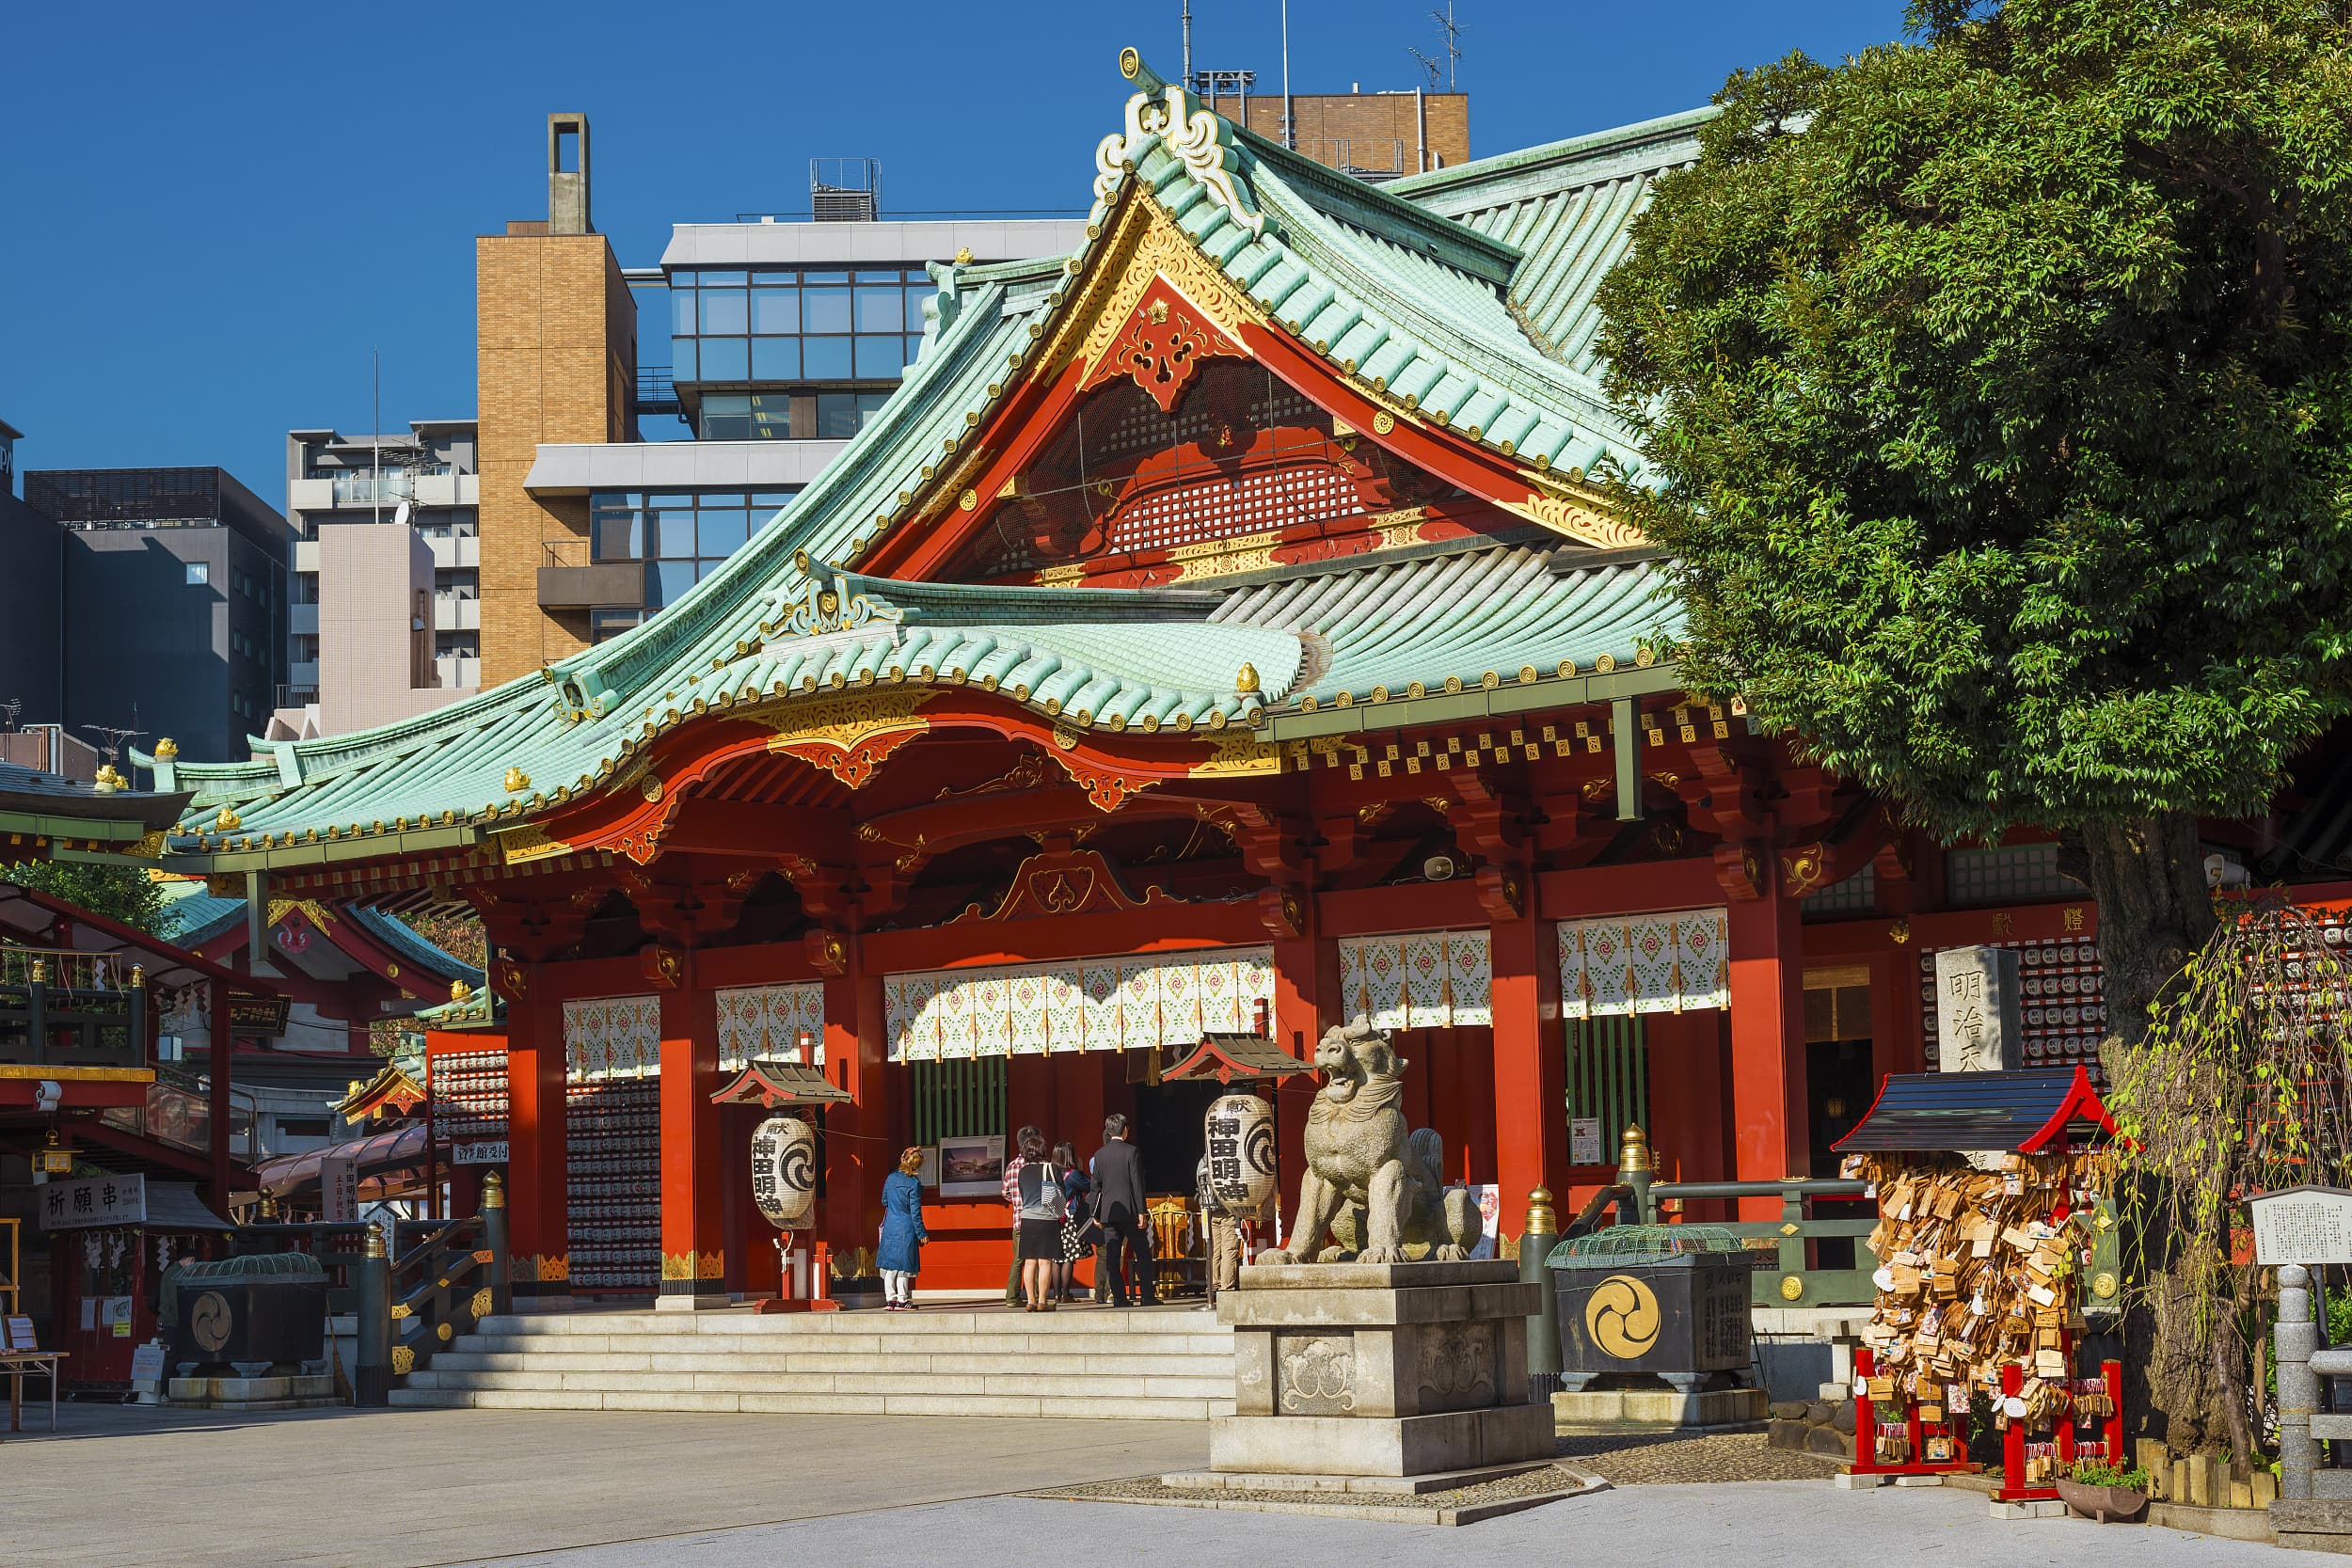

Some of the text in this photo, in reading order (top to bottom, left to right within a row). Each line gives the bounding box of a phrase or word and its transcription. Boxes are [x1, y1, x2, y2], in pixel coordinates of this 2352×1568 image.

[753, 1134, 784, 1214] 神田明神
[1207, 1115, 1250, 1202] 神田明神
[46, 1182, 118, 1217] 祈願串
